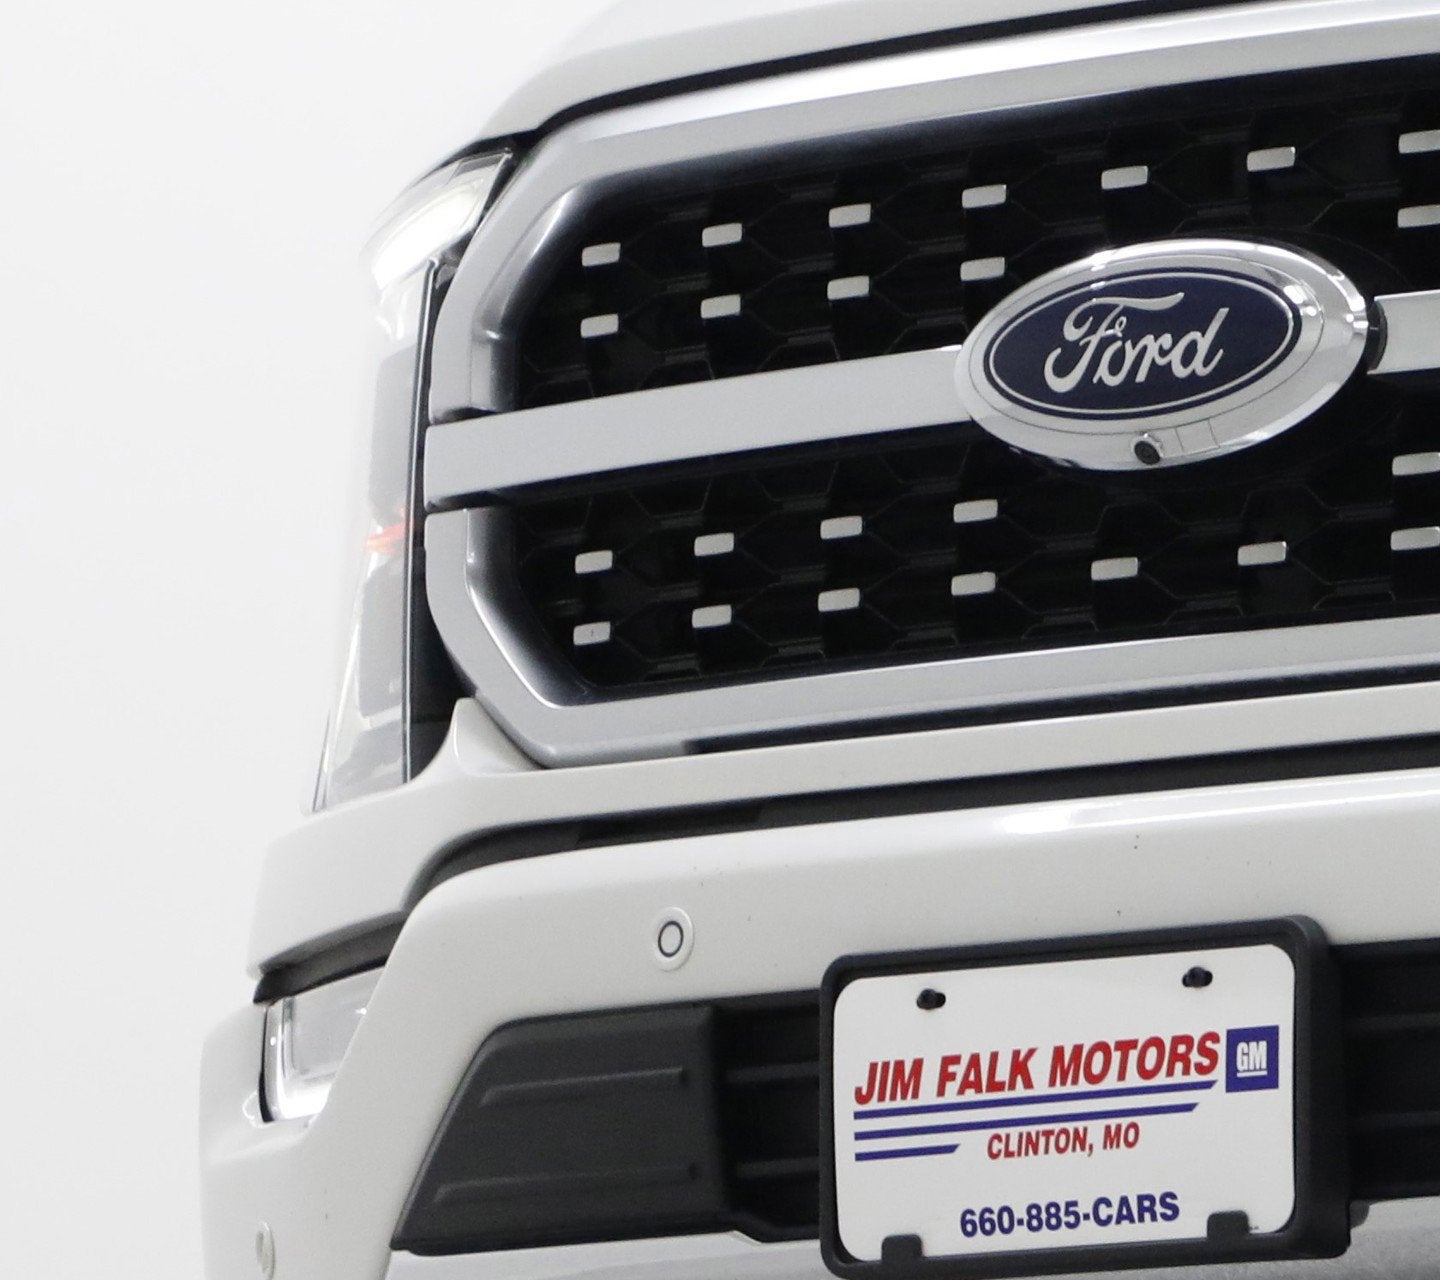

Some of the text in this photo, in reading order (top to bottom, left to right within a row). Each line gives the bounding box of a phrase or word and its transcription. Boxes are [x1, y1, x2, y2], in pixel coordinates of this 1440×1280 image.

[1044, 292, 1229, 393] Ford
[856, 1032, 1220, 1104] JIM FALK MOTORS
[1235, 1040, 1268, 1070] GM
[989, 1123, 1139, 1159] CLINTON, MO
[962, 1192, 1179, 1237] 660-885-CARS
